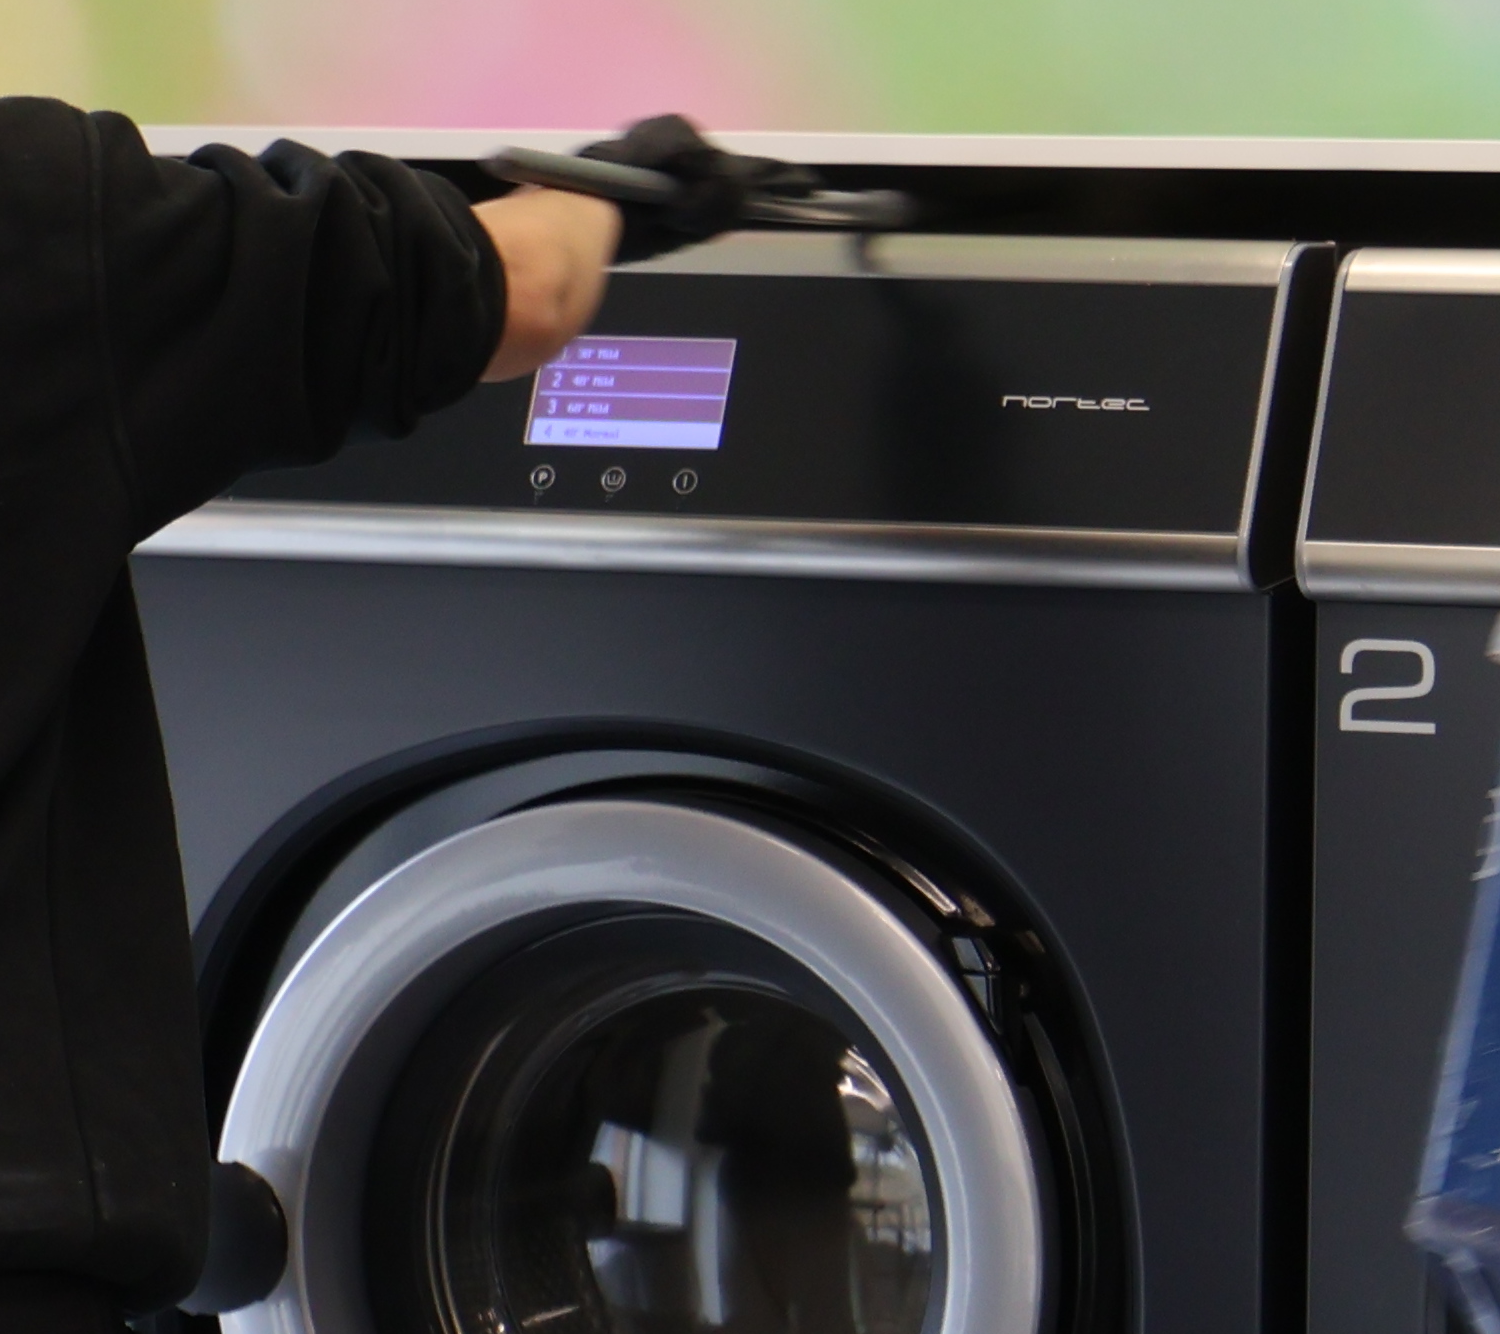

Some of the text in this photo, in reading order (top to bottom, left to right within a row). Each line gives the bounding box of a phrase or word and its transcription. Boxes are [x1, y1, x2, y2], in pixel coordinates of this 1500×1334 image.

[551, 371, 563, 388] 2
[546, 398, 558, 415] 3
[1001, 395, 1151, 412] nortec
[1339, 638, 1437, 735] 2
